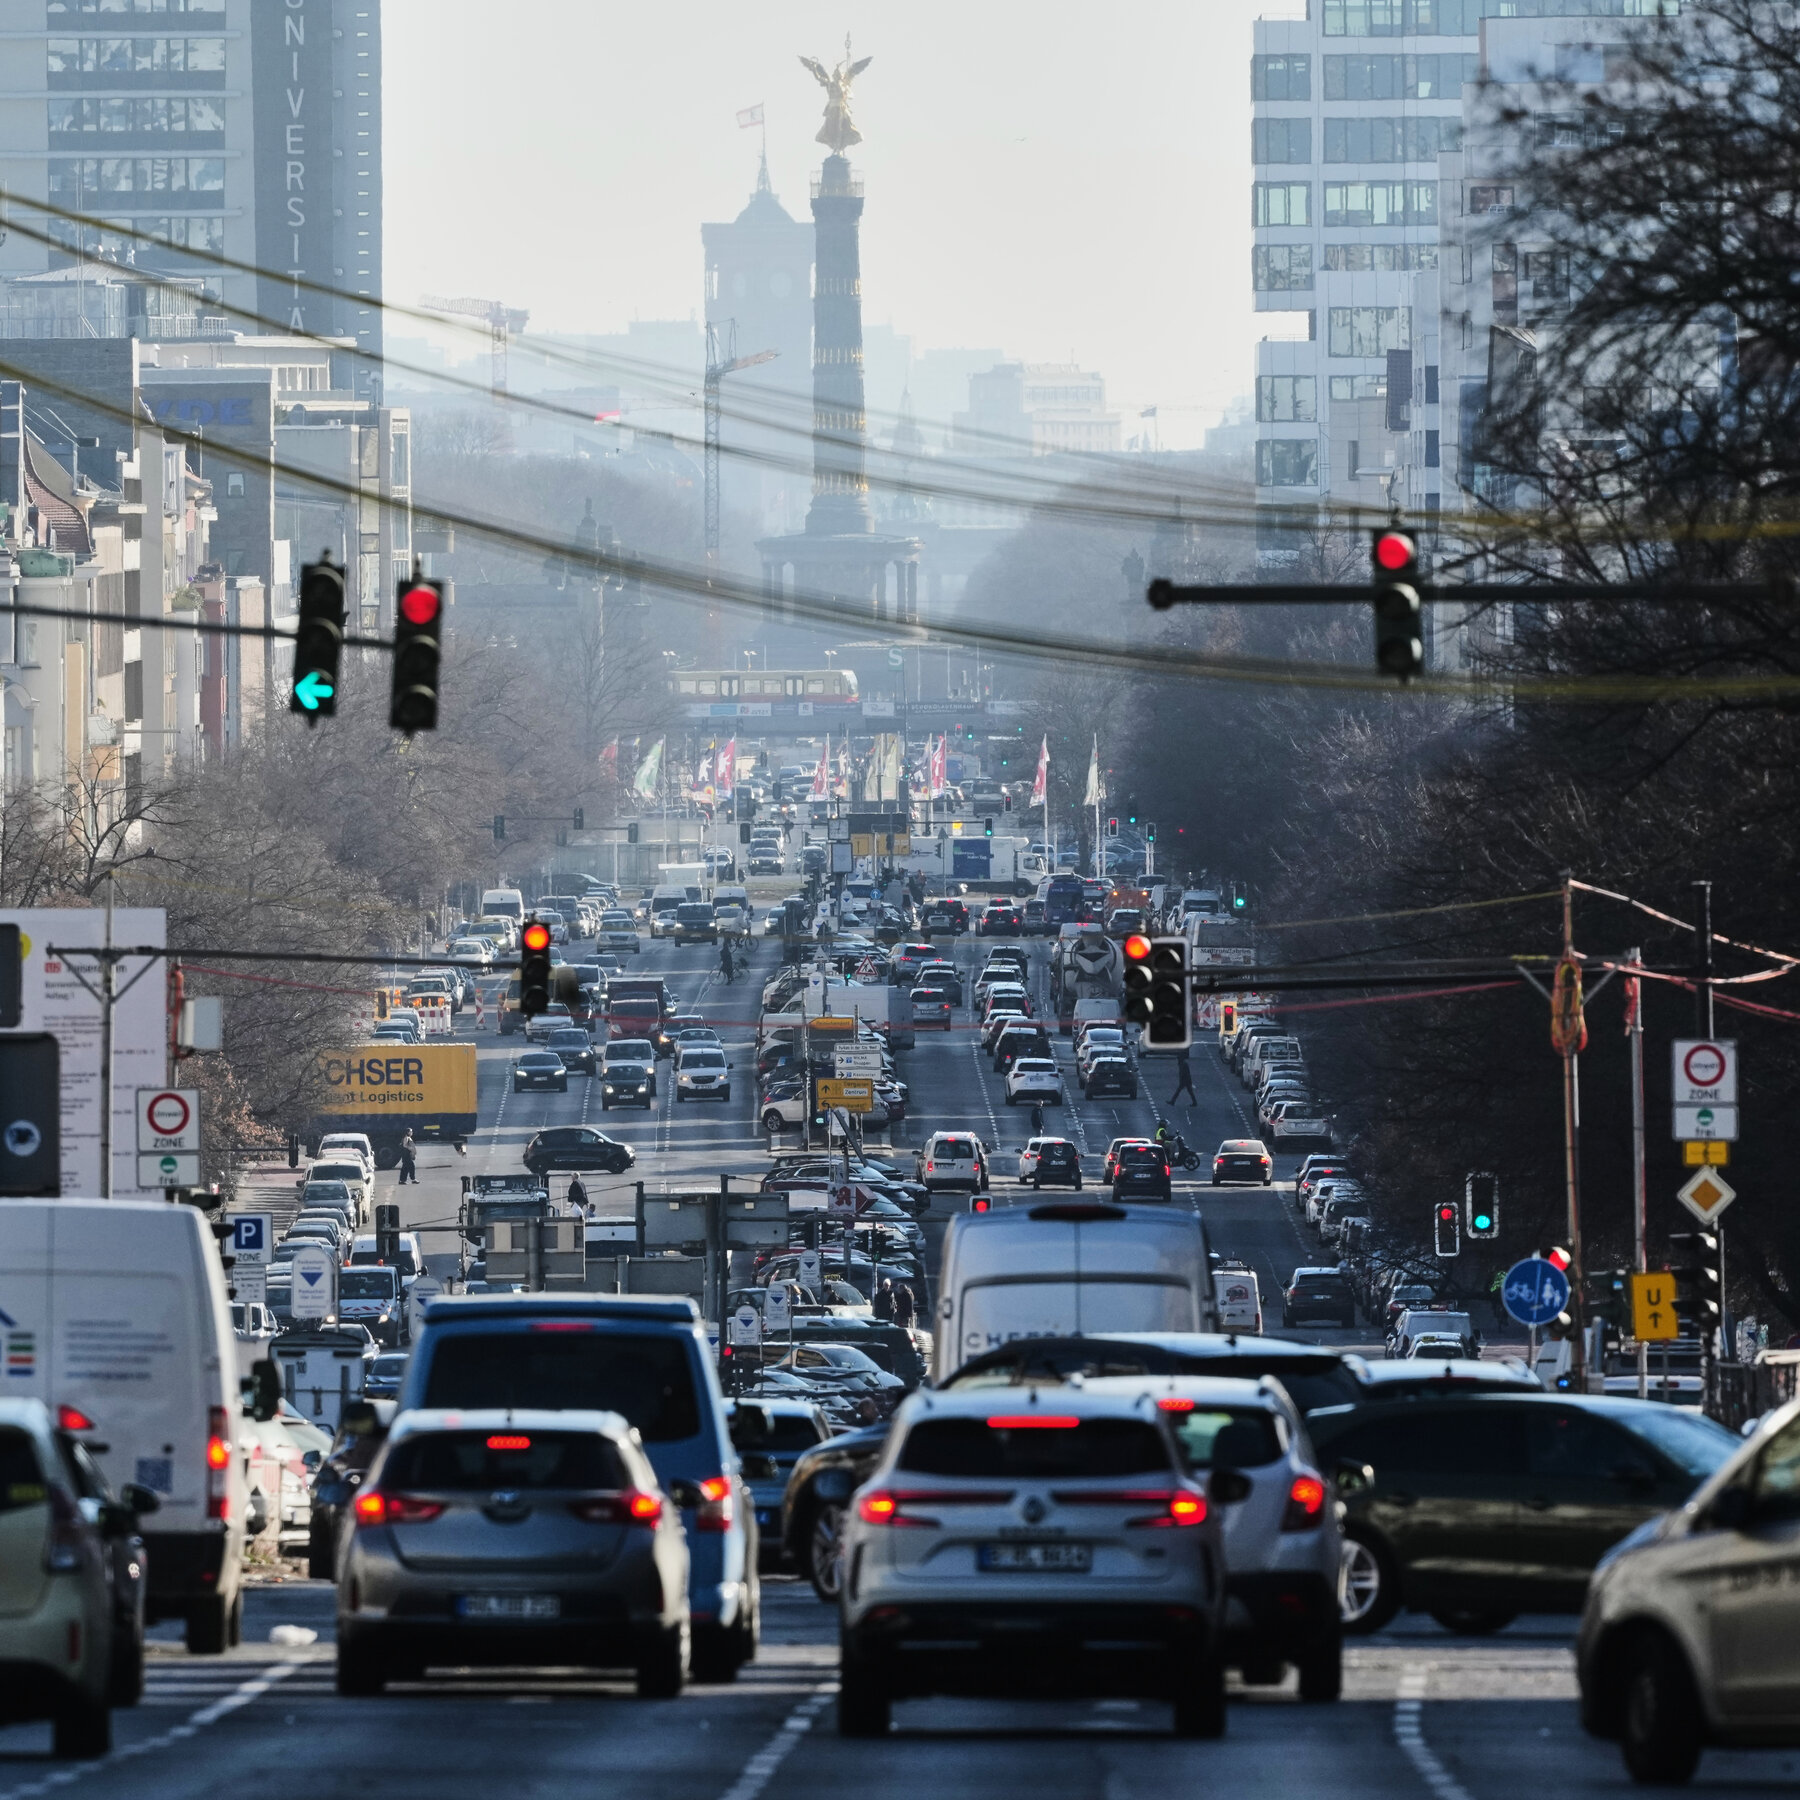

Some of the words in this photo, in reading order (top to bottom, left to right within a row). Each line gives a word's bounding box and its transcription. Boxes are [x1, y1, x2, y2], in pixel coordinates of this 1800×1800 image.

[285, 0, 306, 334] NIVERSITÄ
[887, 647, 903, 666] S
[319, 1057, 424, 1086] CHSER
[360, 1090, 424, 1104] Logistics
[1688, 1088, 1721, 1100] ZONE
[1695, 1126, 1716, 1137] frei
[153, 1137, 185, 1149] ZONE
[159, 1175, 180, 1186] frei
[241, 1222, 256, 1246] P
[237, 1252, 261, 1262] ZONE
[1646, 1288, 1661, 1306] U
